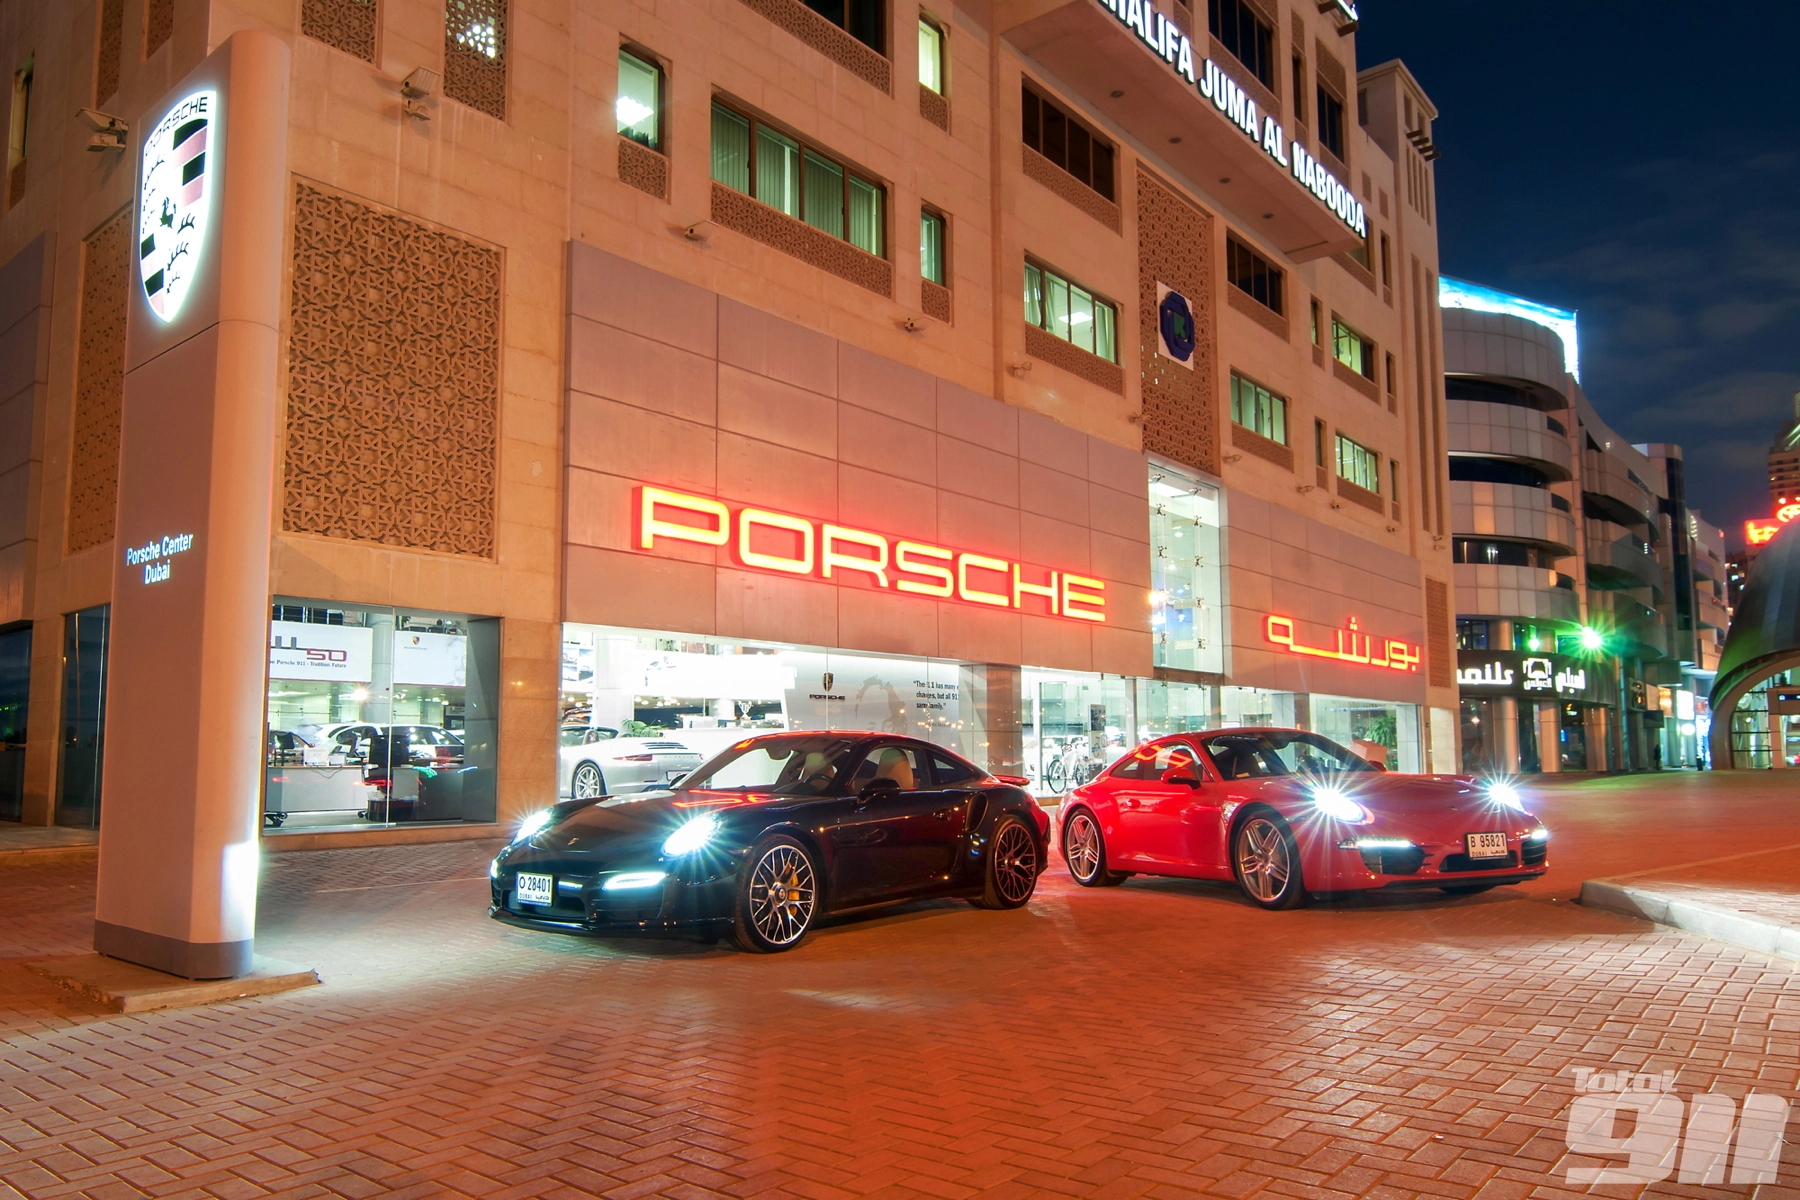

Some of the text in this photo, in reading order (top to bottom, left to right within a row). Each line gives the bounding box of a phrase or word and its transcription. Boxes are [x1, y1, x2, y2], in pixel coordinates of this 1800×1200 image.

[144, 96, 208, 156] PORSCHE
[1098, 0, 1367, 239] ALIFA JUMA AL NABOODA
[126, 533, 194, 567] Porsche Center
[636, 485, 1106, 622] PORSCHE
[143, 559, 171, 585] Dubai
[306, 648, 348, 662] 50
[1470, 834, 1505, 848] B 95821
[527, 876, 551, 892] 28401
